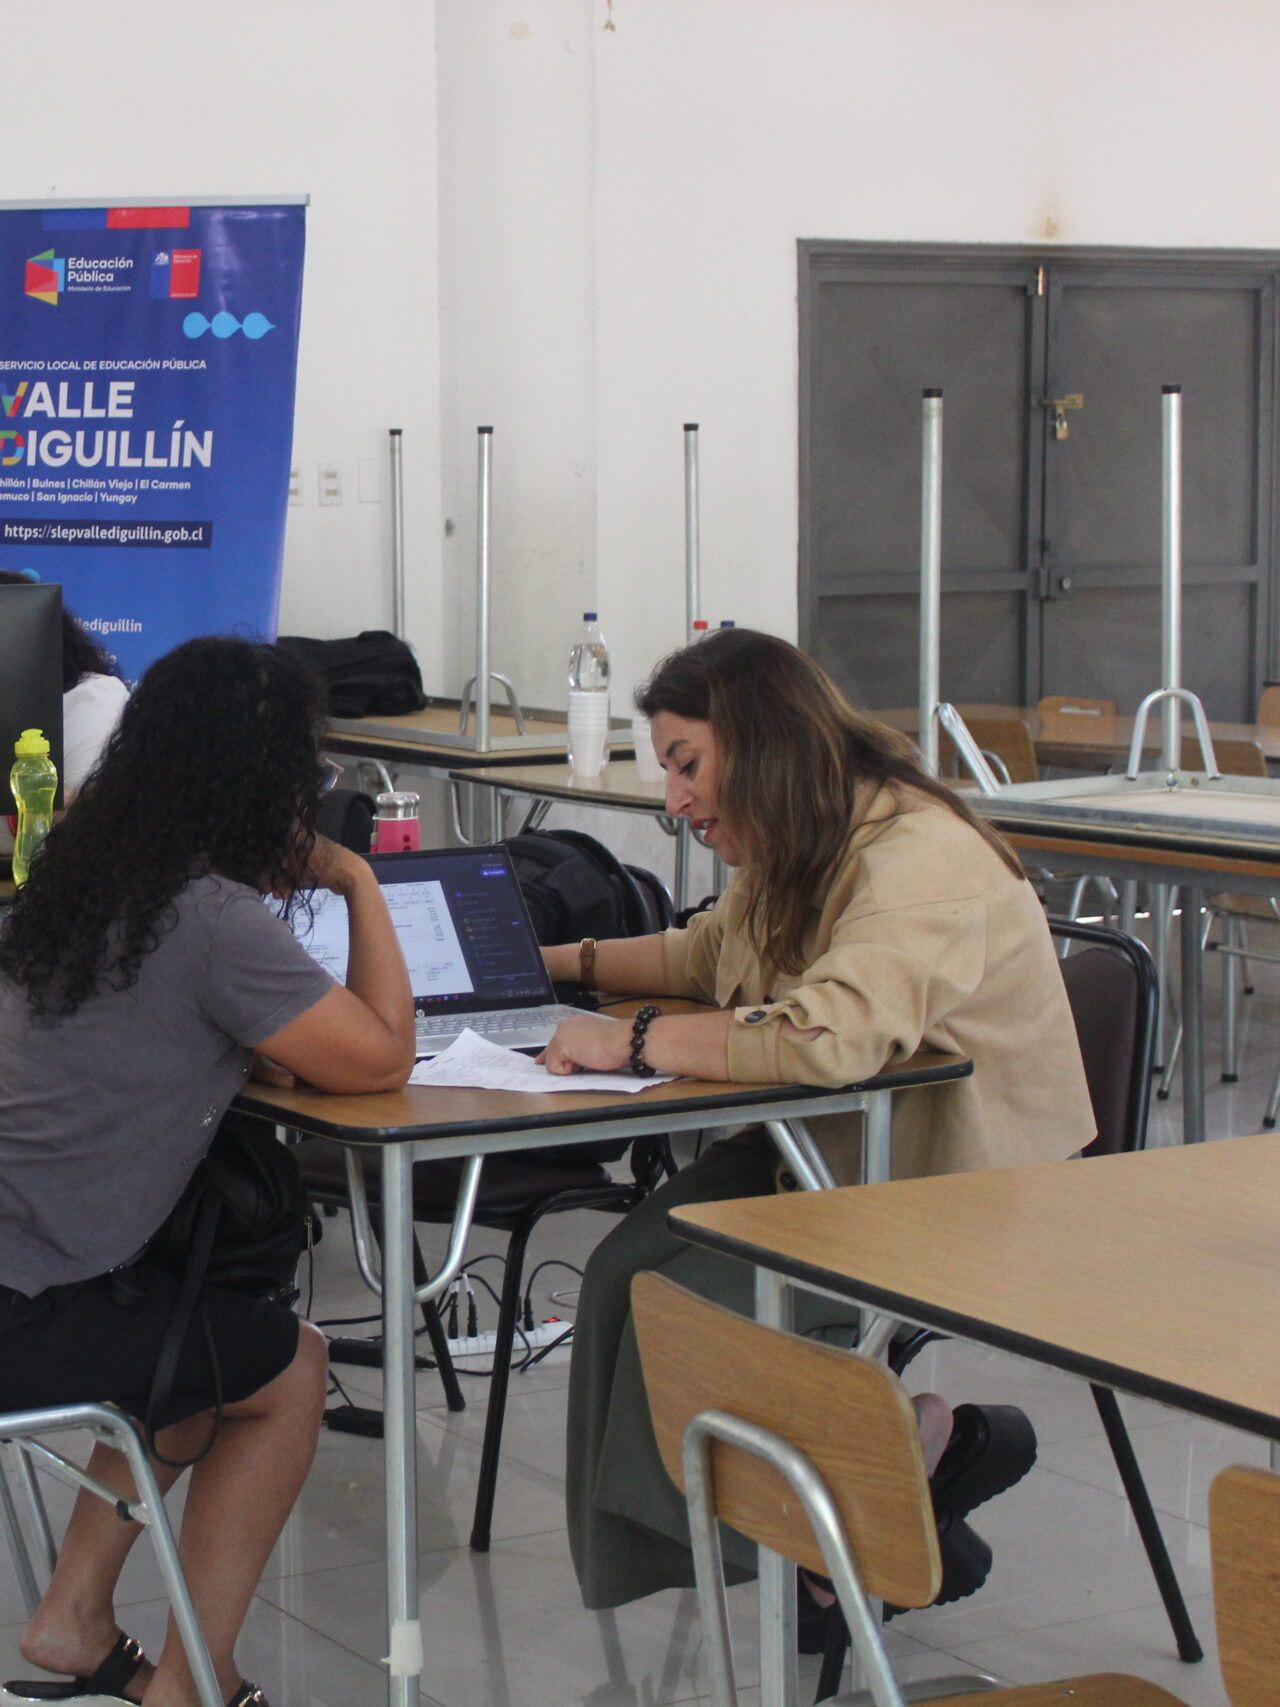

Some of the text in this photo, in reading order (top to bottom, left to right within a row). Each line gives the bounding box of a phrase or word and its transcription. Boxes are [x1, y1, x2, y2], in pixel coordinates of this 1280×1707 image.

[67, 256, 134, 269] Educación
[67, 270, 114, 282] Pública
[47, 360, 81, 370] LOCAL
[83, 360, 98, 370] DE
[99, 358, 160, 370] EDUCACIÓN
[162, 357, 207, 370] PÚBLICA
[32, 478, 66, 489] Bulnes
[72, 479, 106, 489] Chillán
[108, 479, 134, 491] Viejo
[140, 480, 150, 489] El
[151, 480, 191, 490] Carmen
[36, 491, 57, 501] San
[58, 492, 93, 504] Ignacio
[100, 492, 138, 505] Yungay
[4, 524, 204, 544] https://slepvallediguillin.gob.cl
